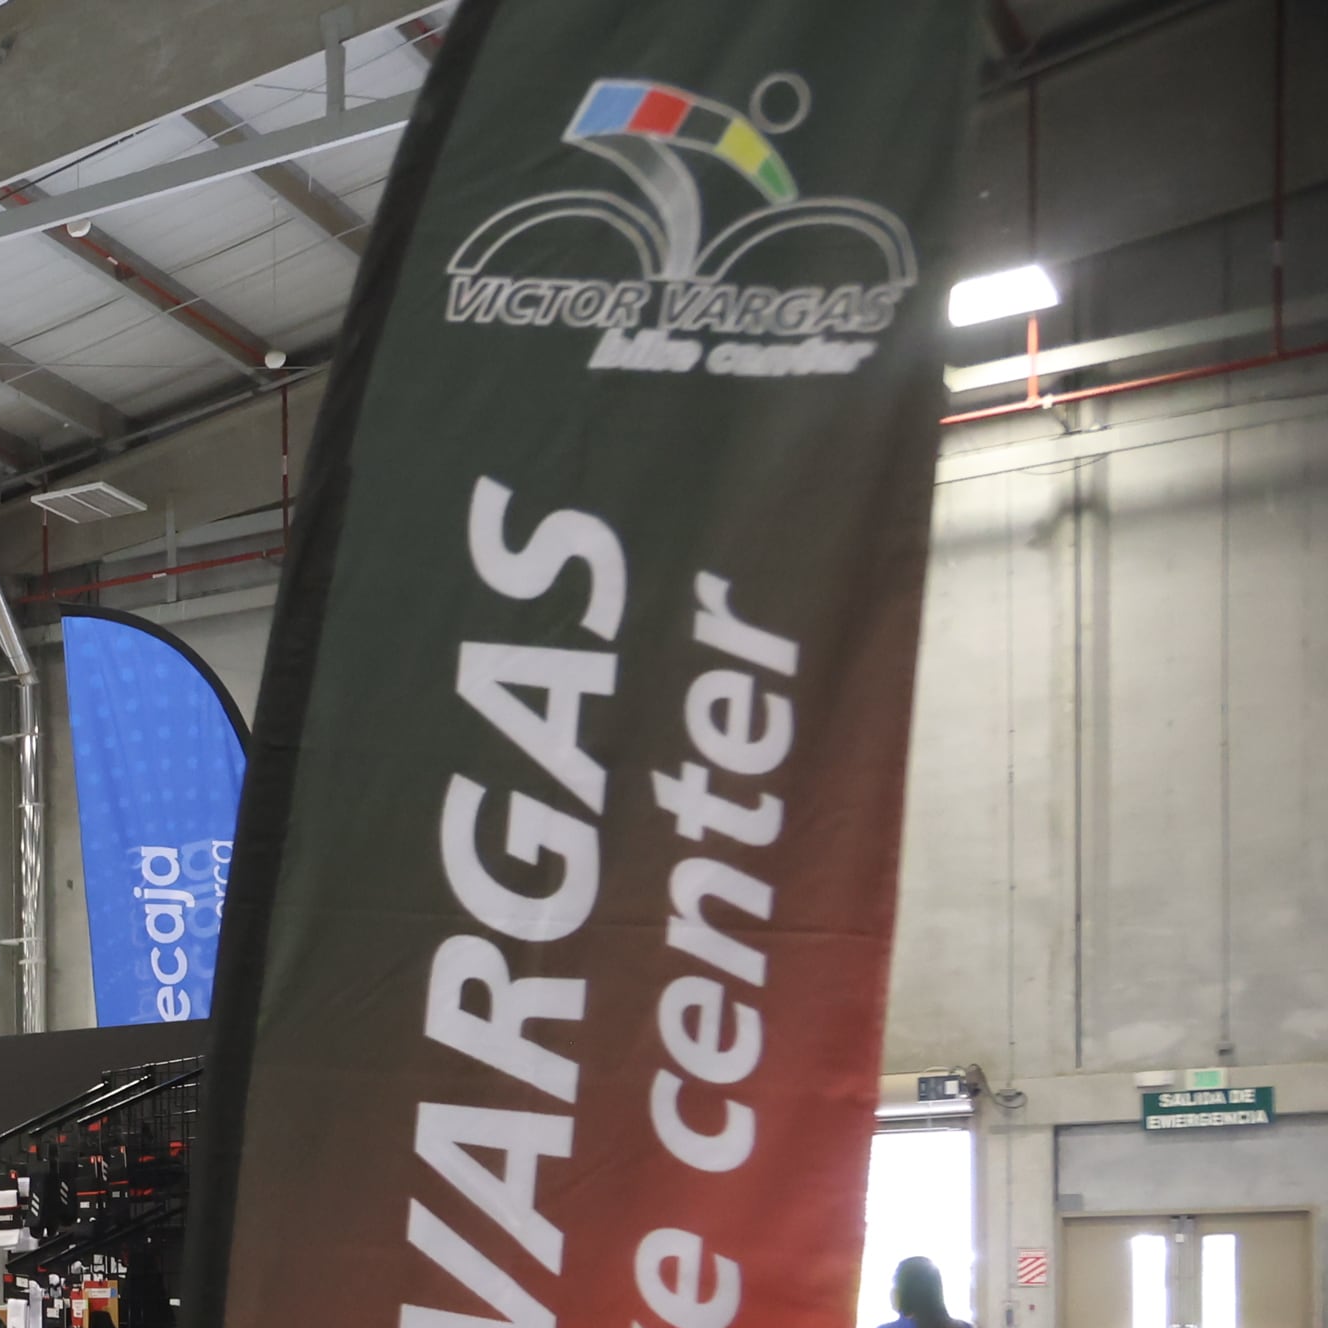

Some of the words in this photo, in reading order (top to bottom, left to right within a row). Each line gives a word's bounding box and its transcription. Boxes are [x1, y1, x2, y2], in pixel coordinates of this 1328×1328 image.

[446, 276, 650, 328] VICTOR
[657, 279, 904, 335] VARGAS
[649, 570, 800, 1172] center
[1158, 1091, 1227, 1107] SALIDA
[1228, 1089, 1256, 1103] DE
